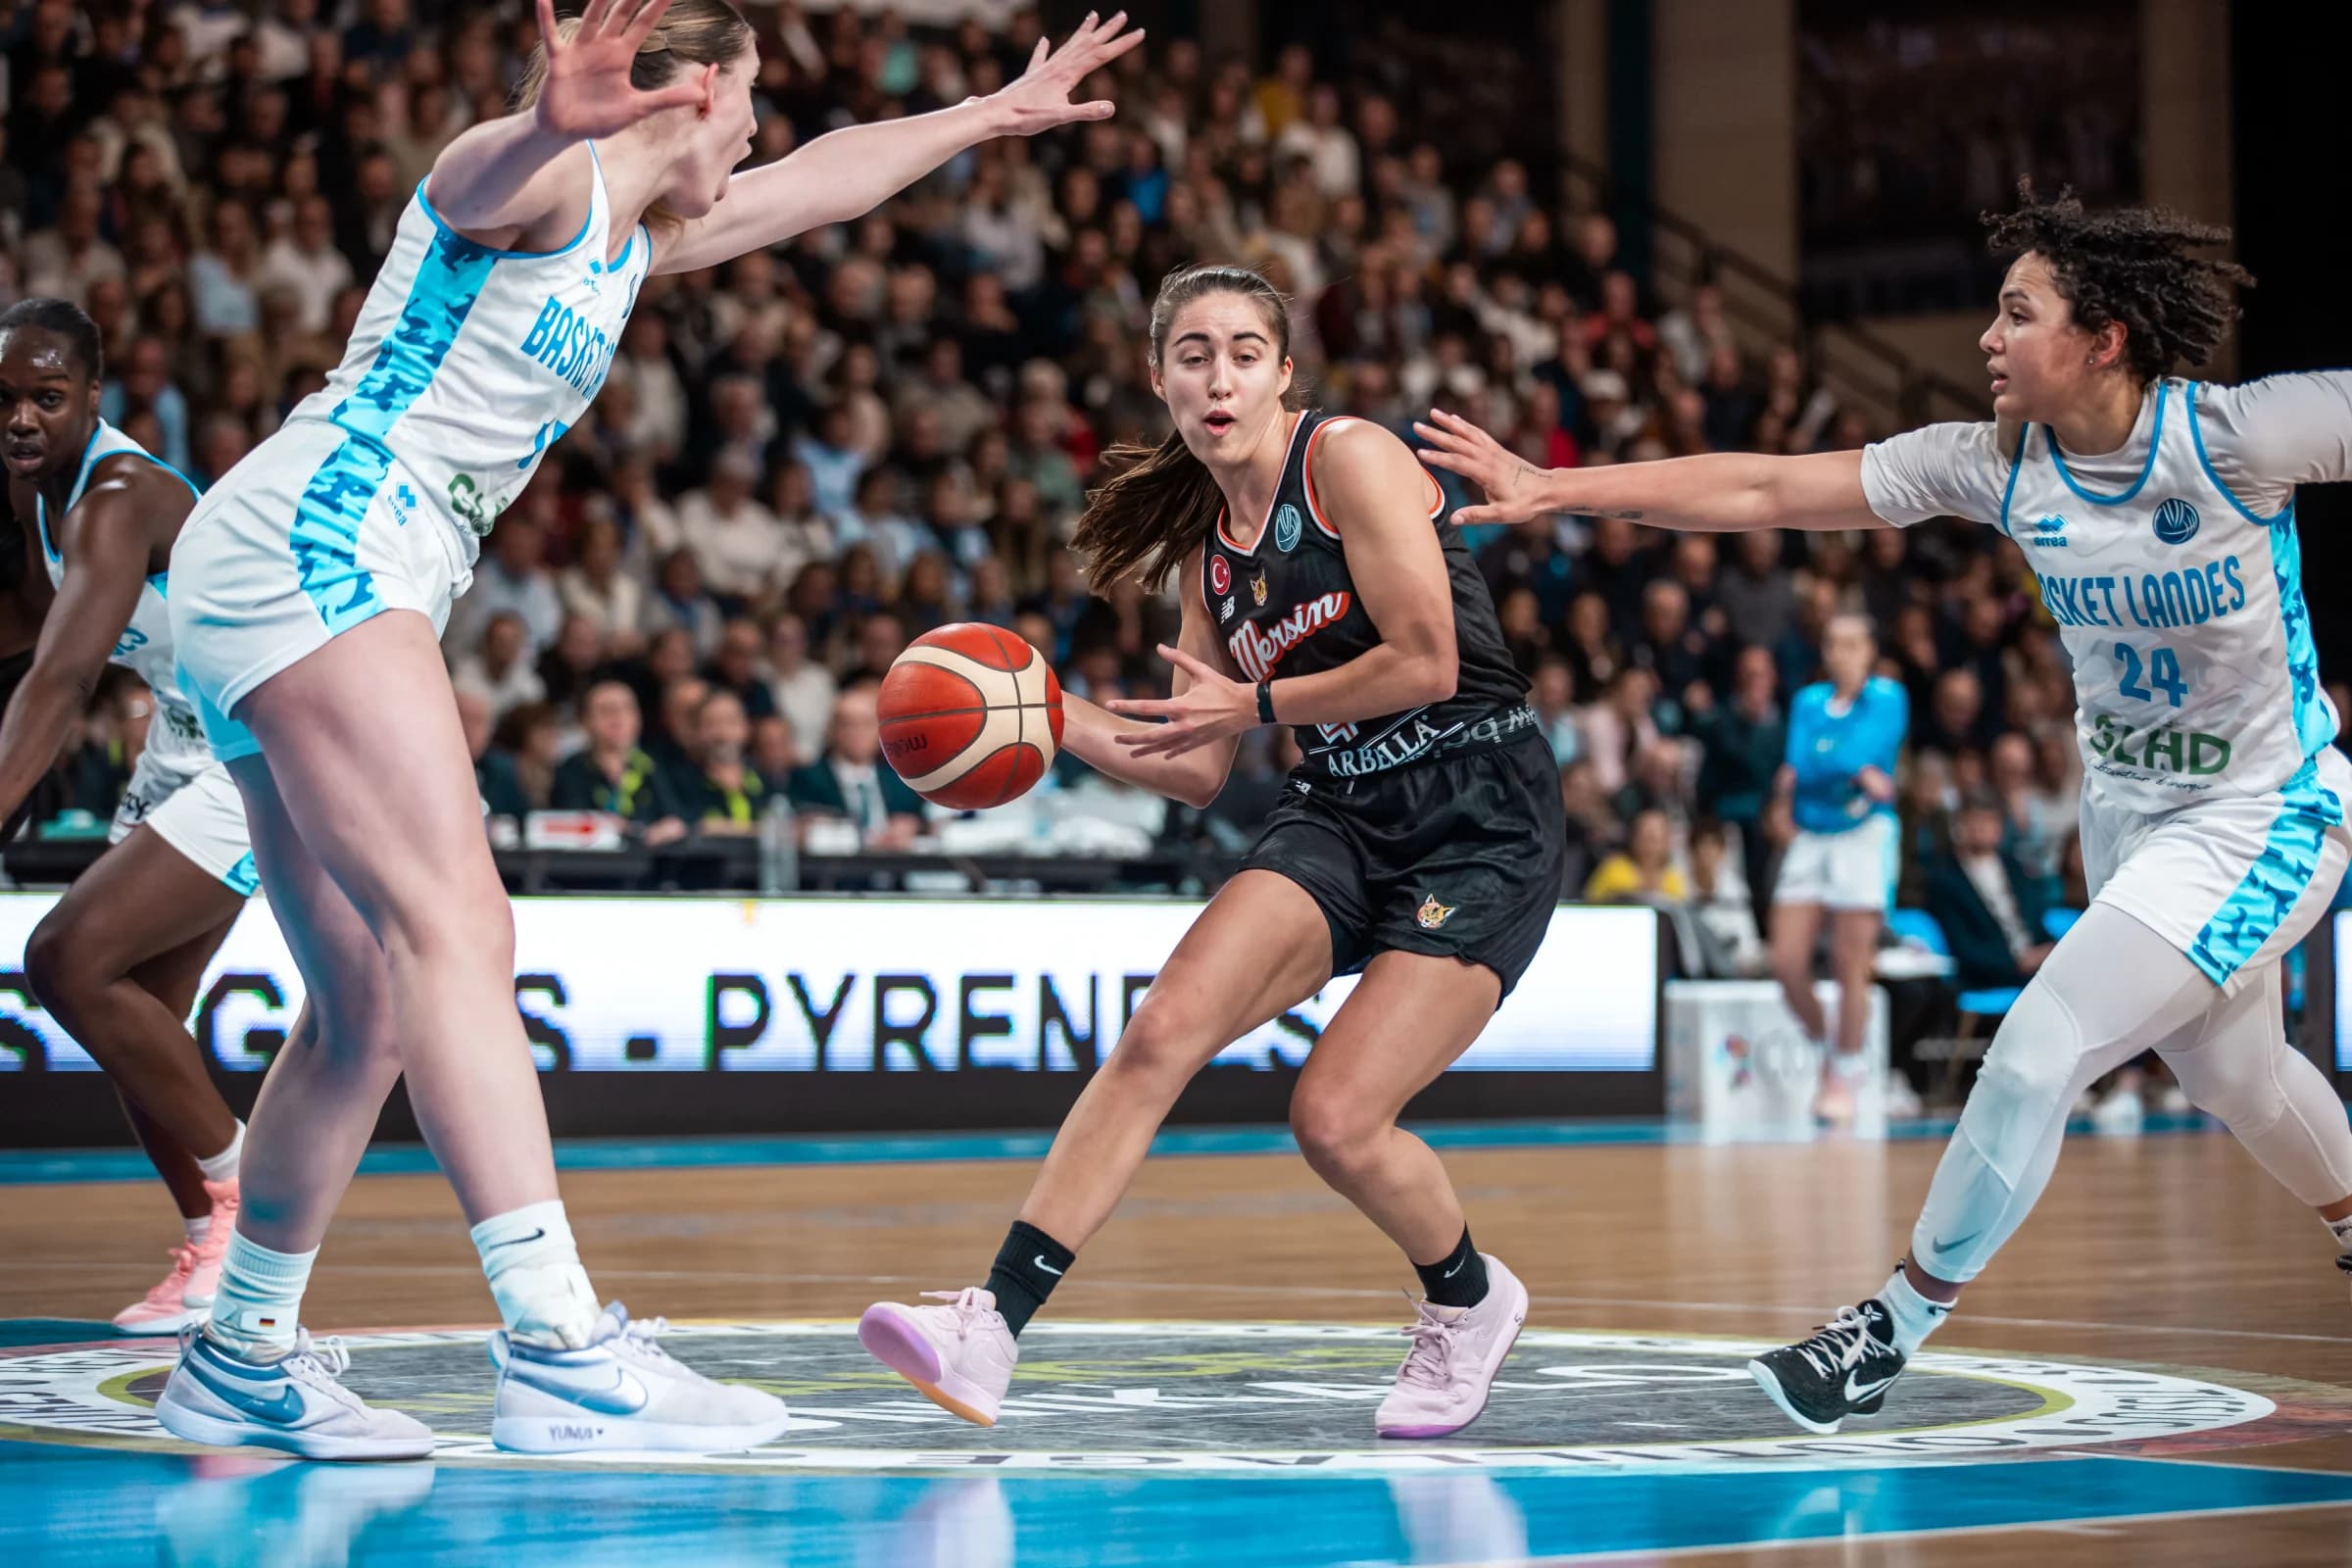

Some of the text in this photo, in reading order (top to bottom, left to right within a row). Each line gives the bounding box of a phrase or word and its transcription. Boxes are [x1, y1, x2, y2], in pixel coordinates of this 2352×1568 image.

[2038, 555, 2245, 628] SKET LANDES
[1229, 591, 1349, 683] Mersin
[2114, 642, 2187, 708] 24
[1328, 718, 1441, 777] ARBELLA
[706, 974, 1325, 1072] PYRENS
